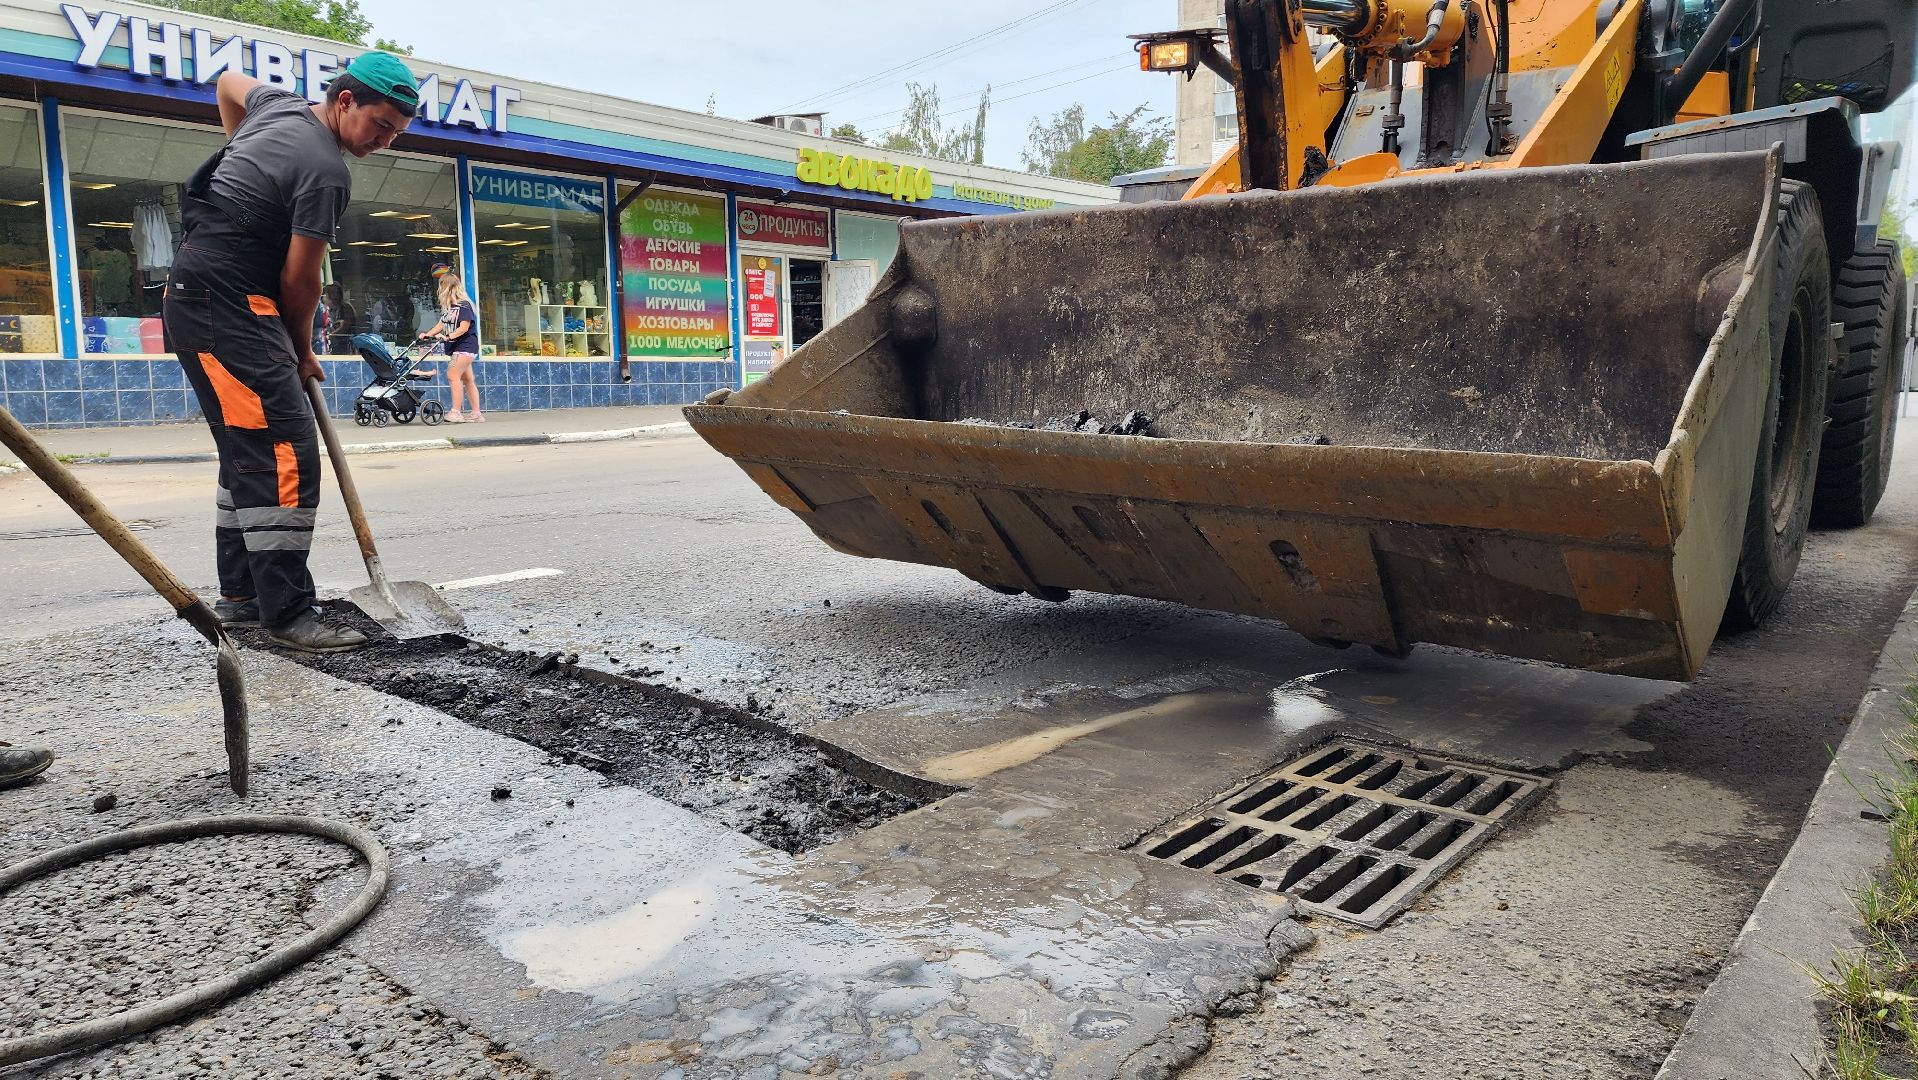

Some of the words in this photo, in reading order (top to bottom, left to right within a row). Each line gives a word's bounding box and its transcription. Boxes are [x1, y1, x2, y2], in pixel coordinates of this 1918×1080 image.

[60, 3, 522, 133] УНИВЕМАГ
[473, 174, 602, 206] УНИВЕРМАГ
[644, 198, 700, 216] ОДЕЖДА
[744, 212, 753, 221] 24
[653, 218, 693, 234] ОБУВЬ
[759, 214, 824, 238] ПРОДУКТЫ
[645, 238, 701, 254] ДЕТСКИЕ
[648, 258, 700, 273] ТОВАРЫ
[648, 277, 701, 294] ПОСУДА
[645, 297, 706, 312] ИГРУШКИ
[638, 315, 714, 331] ХОЗТОВАРЫ
[629, 336, 661, 349] 1000
[667, 335, 723, 350] МЕЛОЧЕЙ
